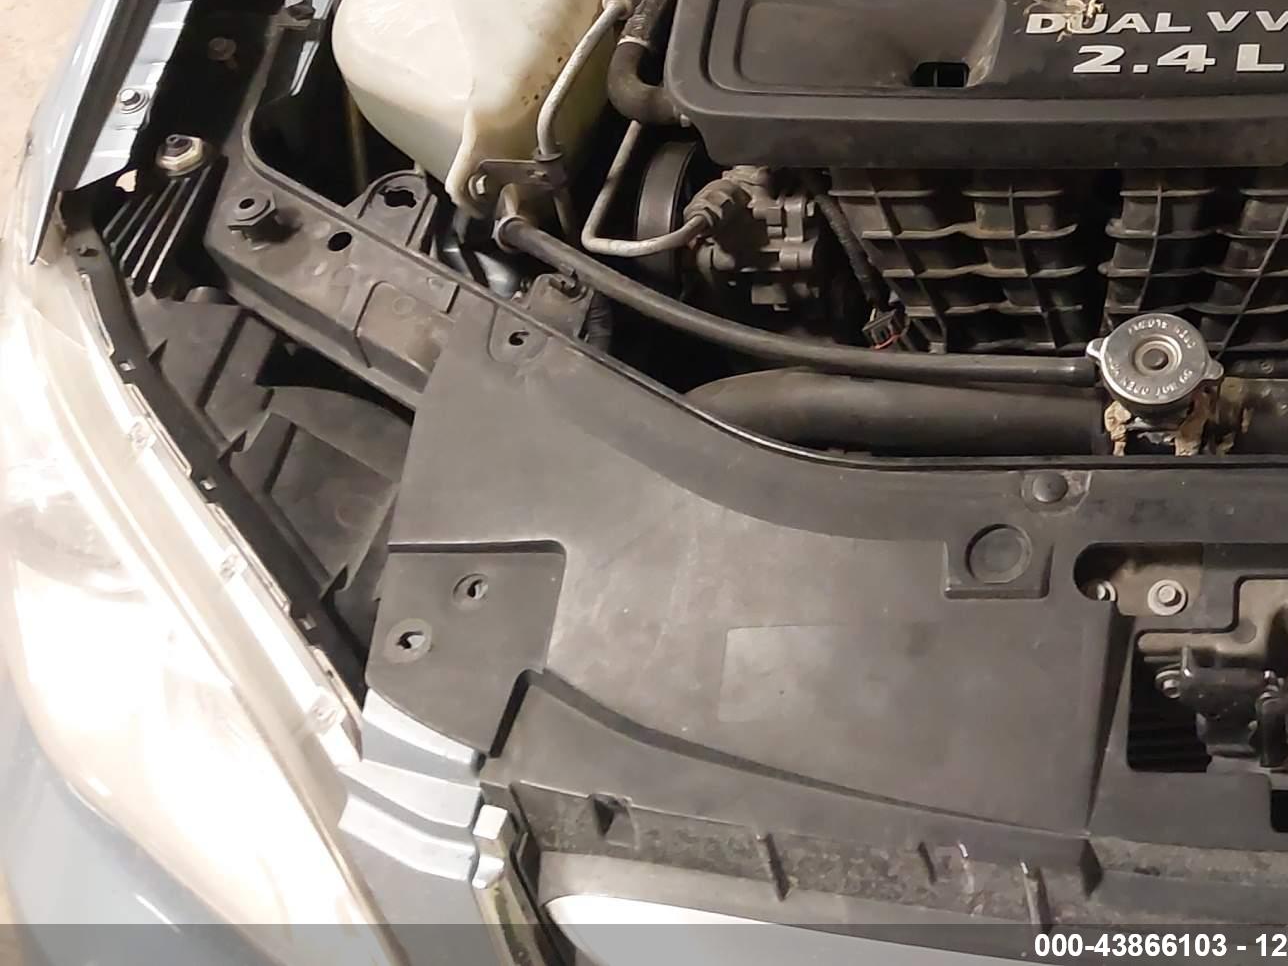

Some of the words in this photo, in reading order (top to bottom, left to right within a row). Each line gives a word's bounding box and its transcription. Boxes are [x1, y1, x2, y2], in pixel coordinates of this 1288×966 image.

[1025, 12, 1192, 35] DUAL
[1072, 43, 1216, 74] 2.4
[1236, 42, 1285, 73] L
